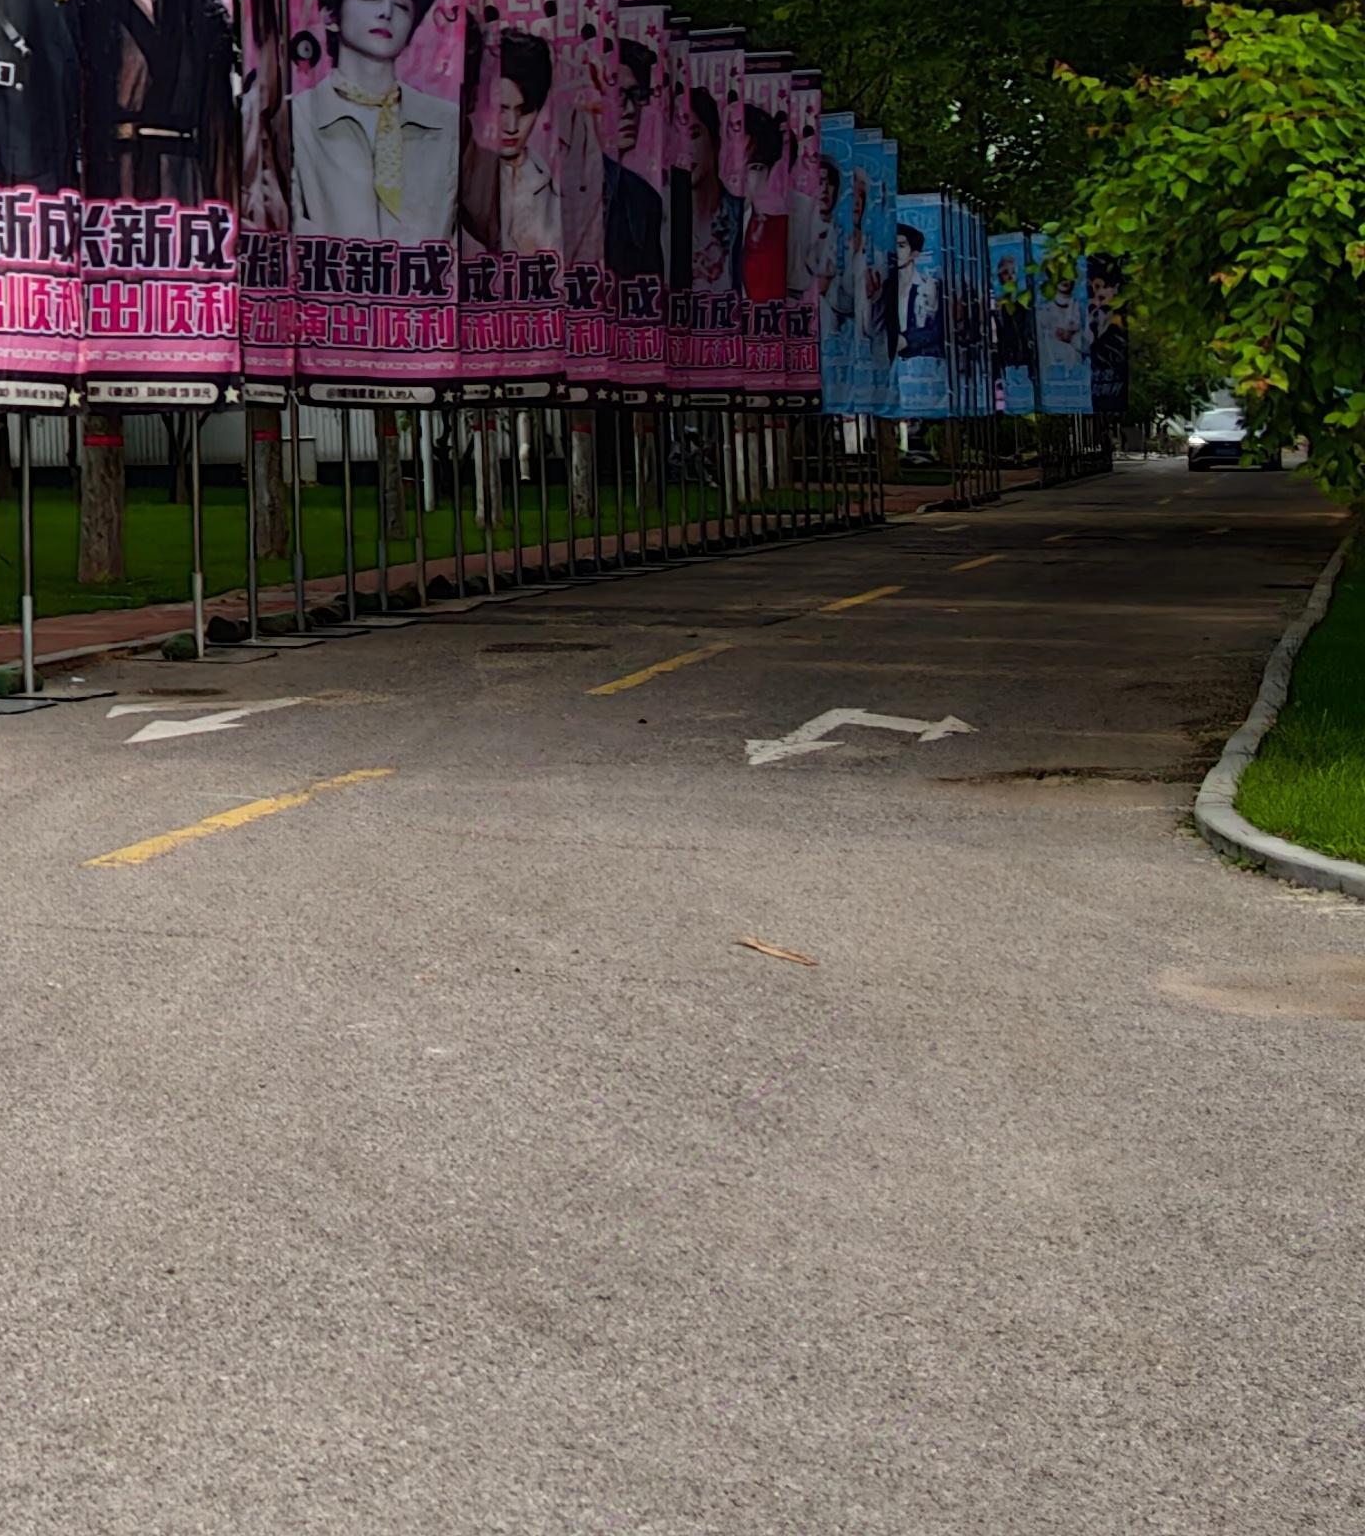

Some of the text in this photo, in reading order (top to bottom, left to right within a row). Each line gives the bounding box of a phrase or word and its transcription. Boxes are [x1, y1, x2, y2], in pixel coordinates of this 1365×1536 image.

[297, 238, 451, 298] 张新成
[84, 279, 241, 337] 出顺利
